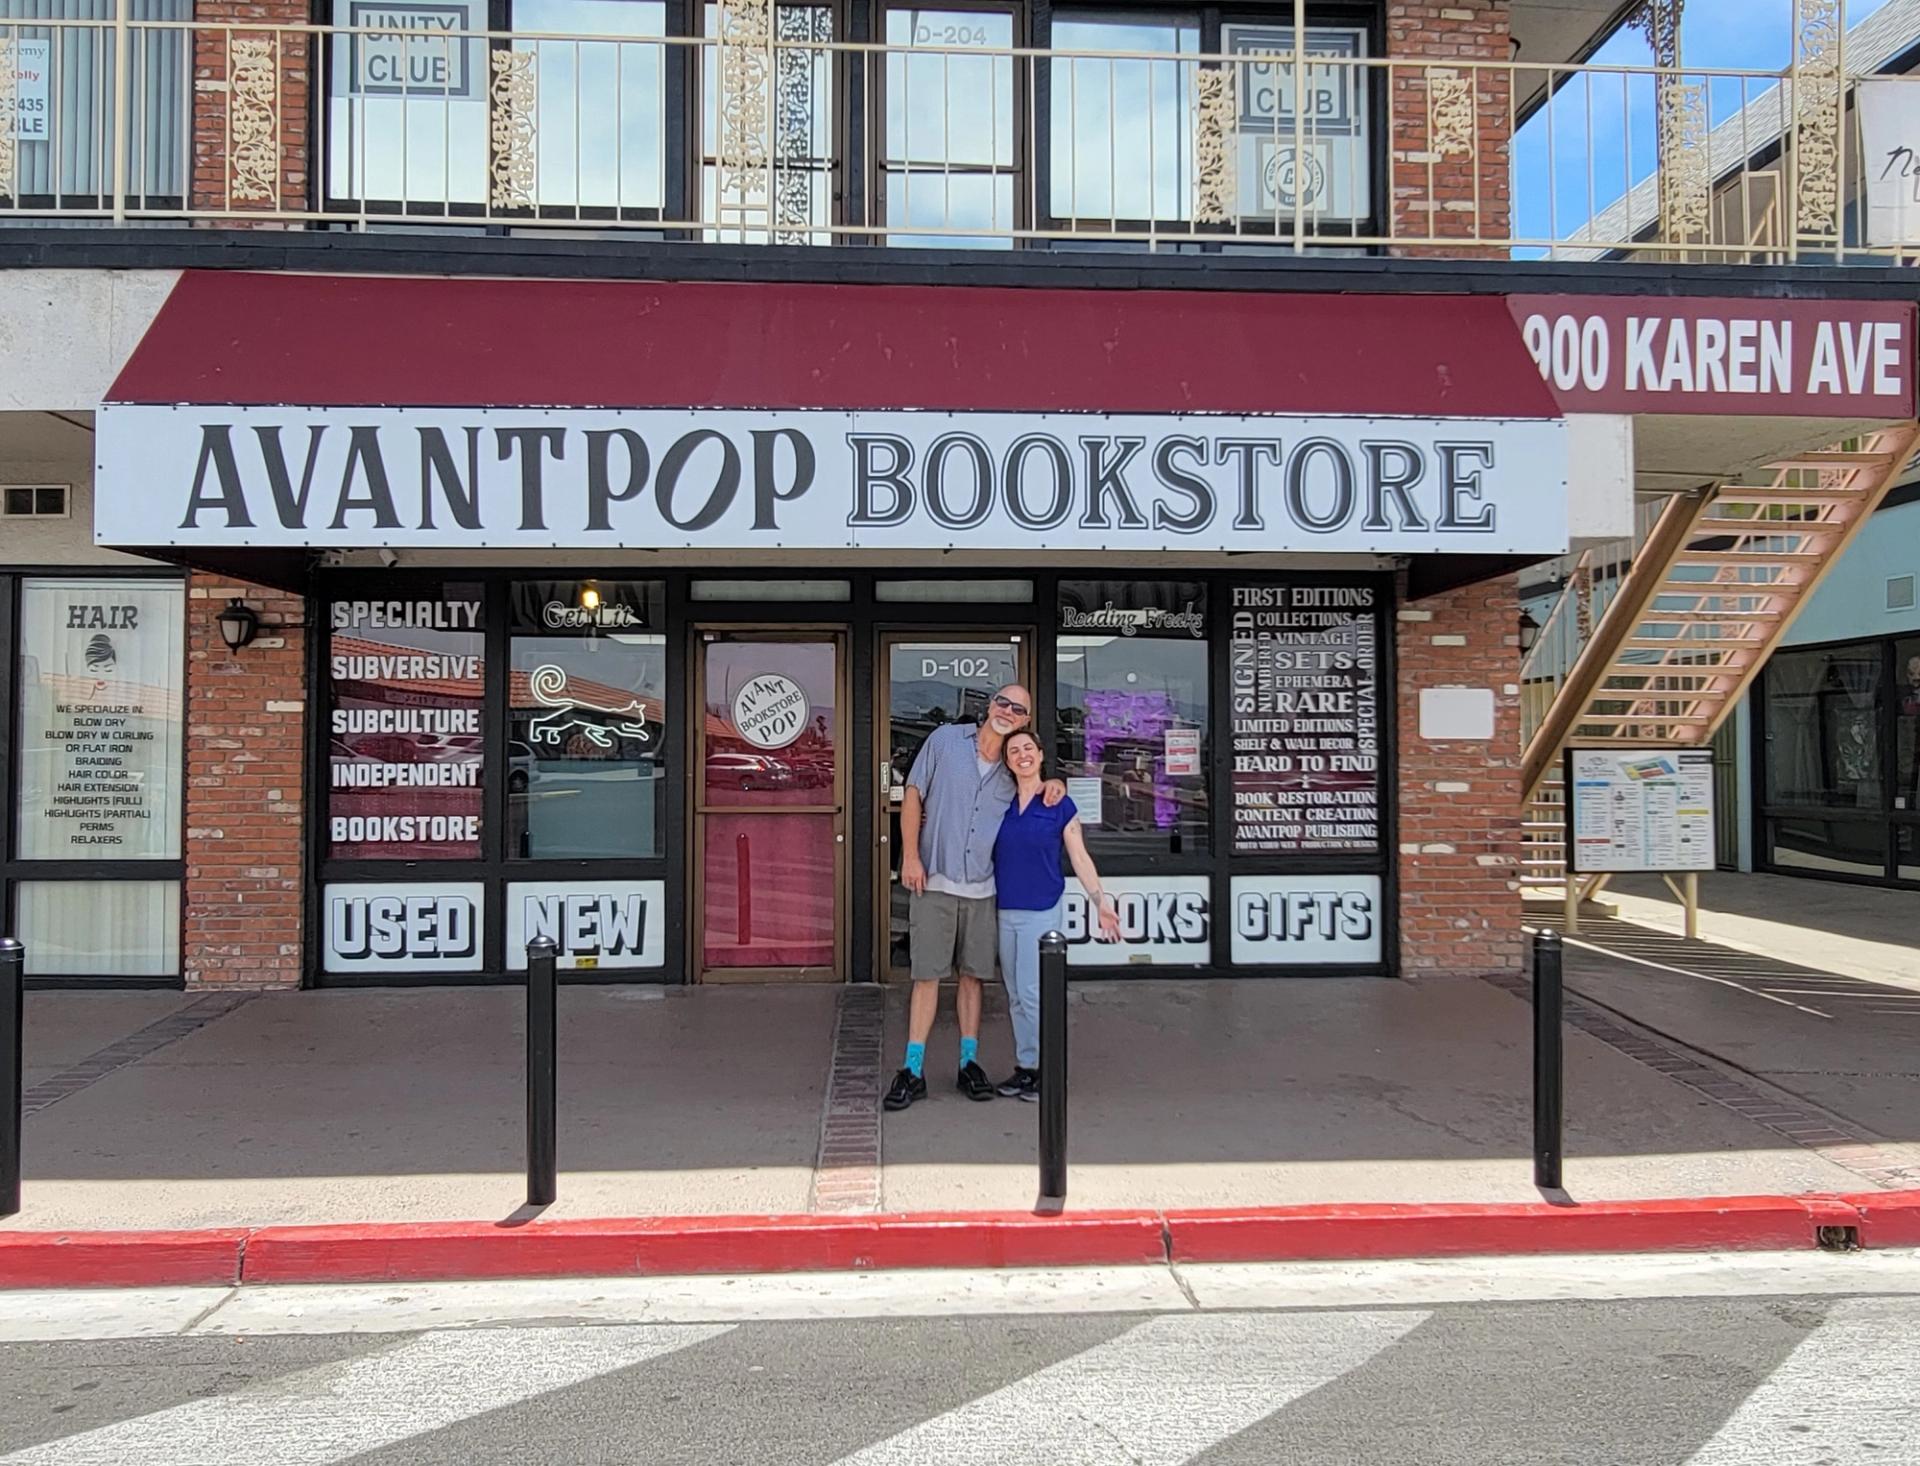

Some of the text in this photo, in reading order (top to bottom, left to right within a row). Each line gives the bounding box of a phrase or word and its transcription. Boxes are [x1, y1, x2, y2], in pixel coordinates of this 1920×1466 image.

[366, 14, 455, 43] UNITY
[915, 25, 987, 46] D-204
[368, 55, 451, 82] CLUB
[1254, 49, 1337, 77] UNTY
[1523, 313, 1901, 395] 900 KAREN AVE
[845, 430, 1496, 535] BOOKSTORE
[1232, 588, 1374, 607] FIRST EDITIONS
[66, 605, 139, 630] HAIR
[332, 601, 481, 629] SPECIALTY
[543, 601, 634, 628] Get Lit
[1062, 601, 1203, 638] Reading Freaks
[1256, 612, 1351, 627] COLLECTIONS
[1275, 632, 1353, 645] VINTAGE
[331, 656, 480, 680] SUBVERSIVE
[921, 658, 990, 678] D-102
[1233, 611, 1255, 713] SIGNED
[1275, 651, 1354, 670] SETS
[1258, 632, 1272, 712] NUMBERED
[1275, 675, 1353, 688] EPHEMERA
[1356, 612, 1377, 749] SPECIAL ORDER
[741, 680, 786, 716] AVANT
[1275, 692, 1354, 713] RARE
[56, 705, 72, 713] WE
[74, 705, 129, 714] SPECIALIZE
[740, 691, 802, 732] BOOKSTORE
[73, 718, 126, 727] BLOW DRY
[332, 709, 480, 734] SUBCULTURE
[1233, 719, 1354, 733] LIMITED EDITIONS
[45, 731, 74, 739] BLOW
[77, 731, 98, 740] DRY
[112, 731, 154, 740] CURLING
[1233, 738, 1268, 750] SHELF
[1270, 738, 1281, 750] &
[1284, 738, 1317, 750] WALL
[65, 744, 133, 753] OR FLAT IRON
[75, 757, 122, 766] BRAIDING
[1234, 754, 1377, 772] HARD TO FIND
[68, 770, 128, 779] HAIR COLOR
[332, 763, 480, 787] INDEPENDENT
[57, 783, 139, 792] HAIR EXTENSION
[1234, 791, 1377, 805] BOOK RESTORATION
[53, 796, 110, 805] HIGHLIGHTS
[44, 809, 101, 818] HIGHLIGHTS
[1234, 807, 1377, 821] CONTENT CREATION
[80, 822, 114, 831] PERMS
[330, 816, 479, 842] BOOKSTORE
[1235, 824, 1377, 839] AVANTPOP PUBLISHING
[71, 836, 122, 844] RELAXERS
[524, 894, 647, 956] NEW
[1064, 893, 1209, 944] BOOKS
[1237, 892, 1373, 941] GIFTS
[332, 896, 476, 959] USED
